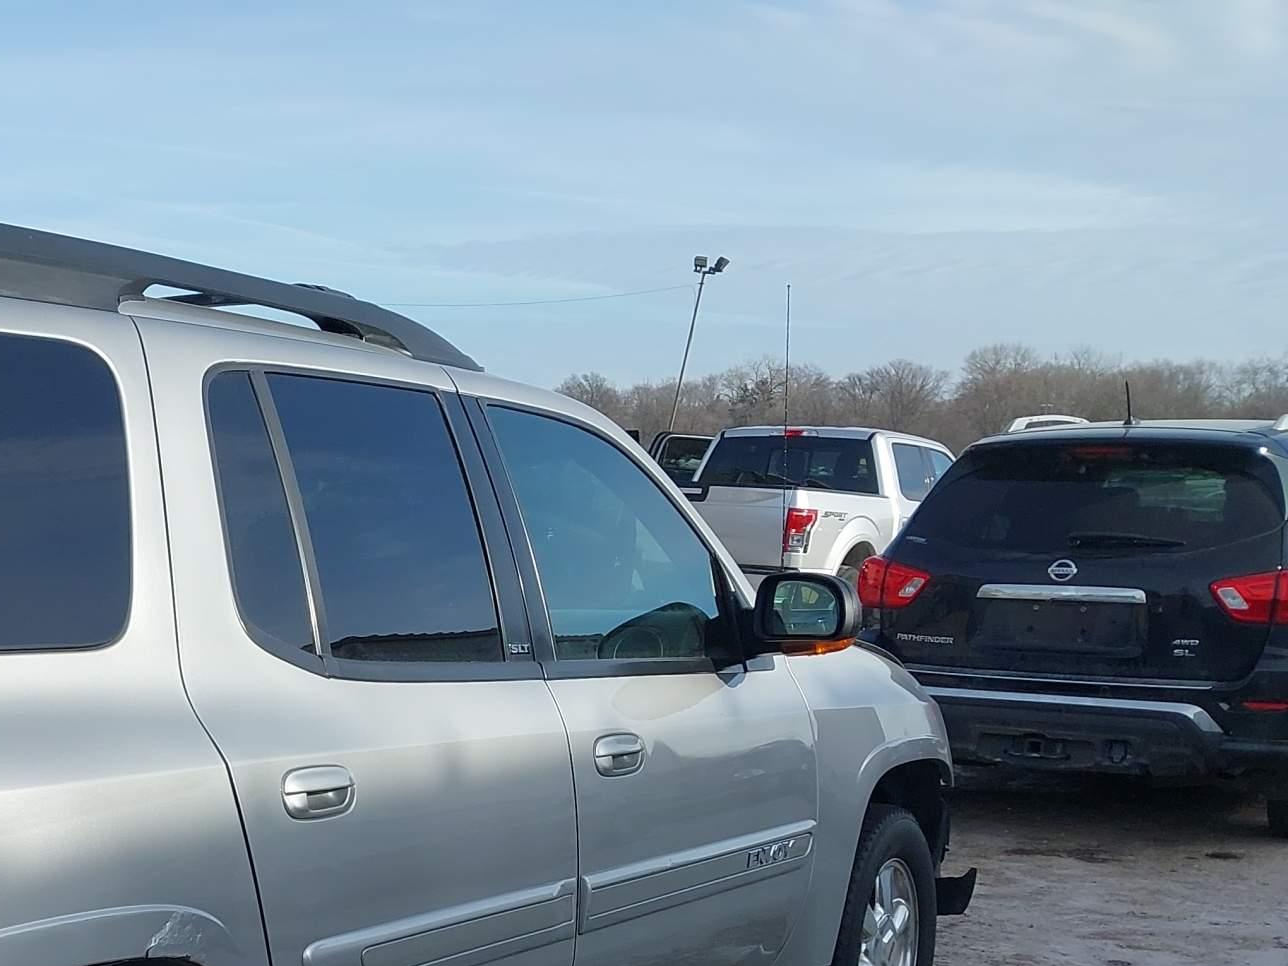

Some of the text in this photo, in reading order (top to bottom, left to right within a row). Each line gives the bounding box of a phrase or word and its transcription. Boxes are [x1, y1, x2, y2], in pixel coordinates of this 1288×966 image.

[896, 632, 954, 644] PATHFINDER
[511, 643, 529, 653] SLT
[1173, 649, 1196, 657] SL
